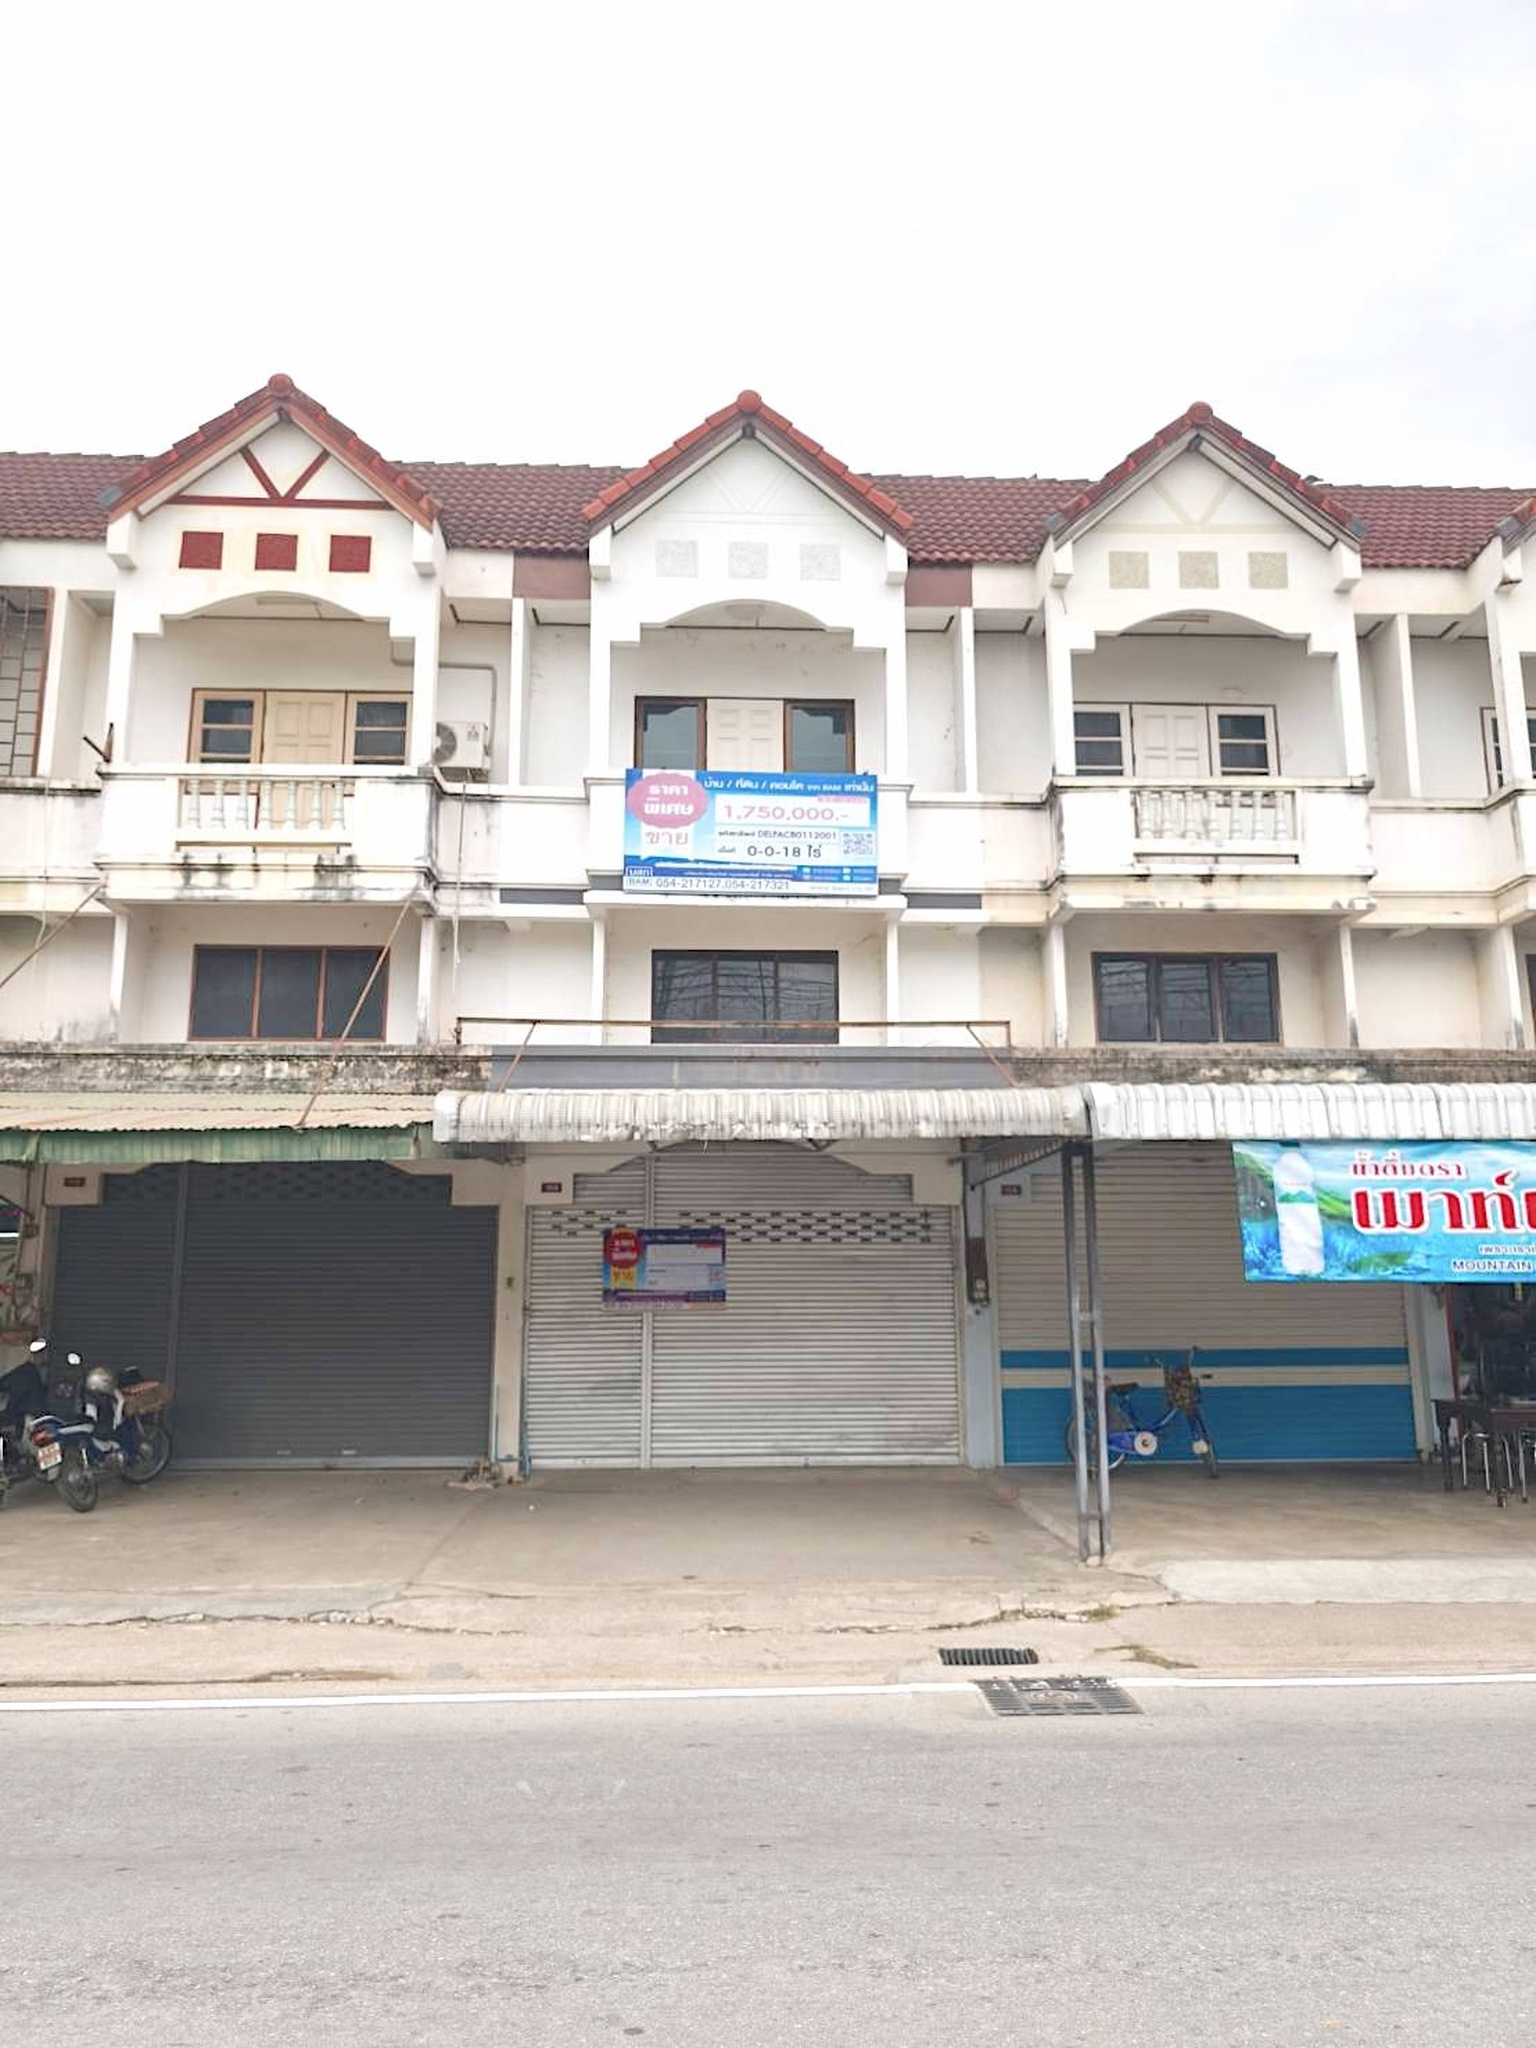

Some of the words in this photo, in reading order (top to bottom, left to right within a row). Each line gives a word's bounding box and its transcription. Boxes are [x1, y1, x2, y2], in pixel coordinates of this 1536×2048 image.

[704, 776, 724, 788] บ้าน
[727, 780, 733, 788] /
[762, 781, 768, 789] /
[649, 785, 689, 796] ราคา
[644, 797, 695, 815] พิเศษ
[724, 804, 850, 821] 1,750,000.-
[645, 831, 689, 845] ขาย
[747, 845, 801, 858] 0-0-18
[807, 844, 822, 858] ไร่
[1453, 1260, 1531, 1271] MOUNTAIN
